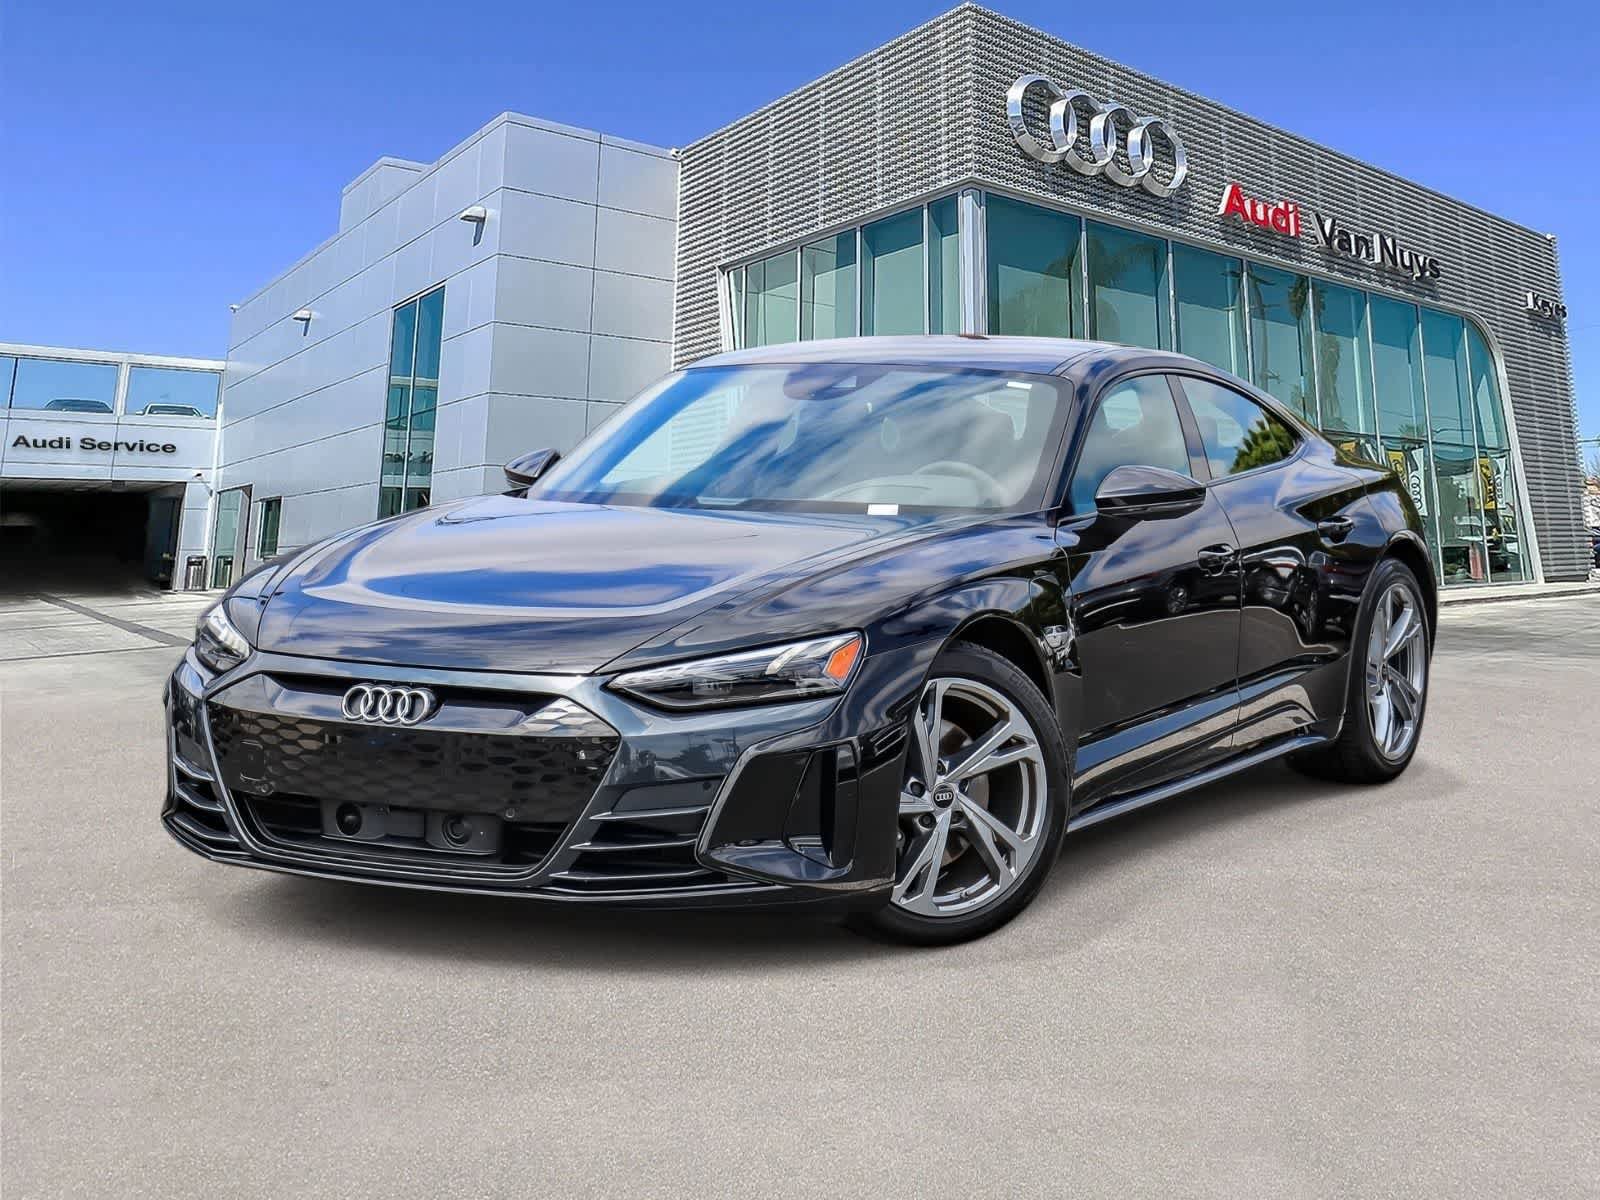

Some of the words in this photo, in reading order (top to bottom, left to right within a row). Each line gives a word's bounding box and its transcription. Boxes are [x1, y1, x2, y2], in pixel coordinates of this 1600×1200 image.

[1216, 182, 1302, 238] Audi
[1311, 212, 1372, 260] Van
[1373, 233, 1441, 280] Nuys
[1526, 291, 1568, 319] Keyes
[12, 434, 72, 450] Audi
[79, 437, 178, 454] Service
